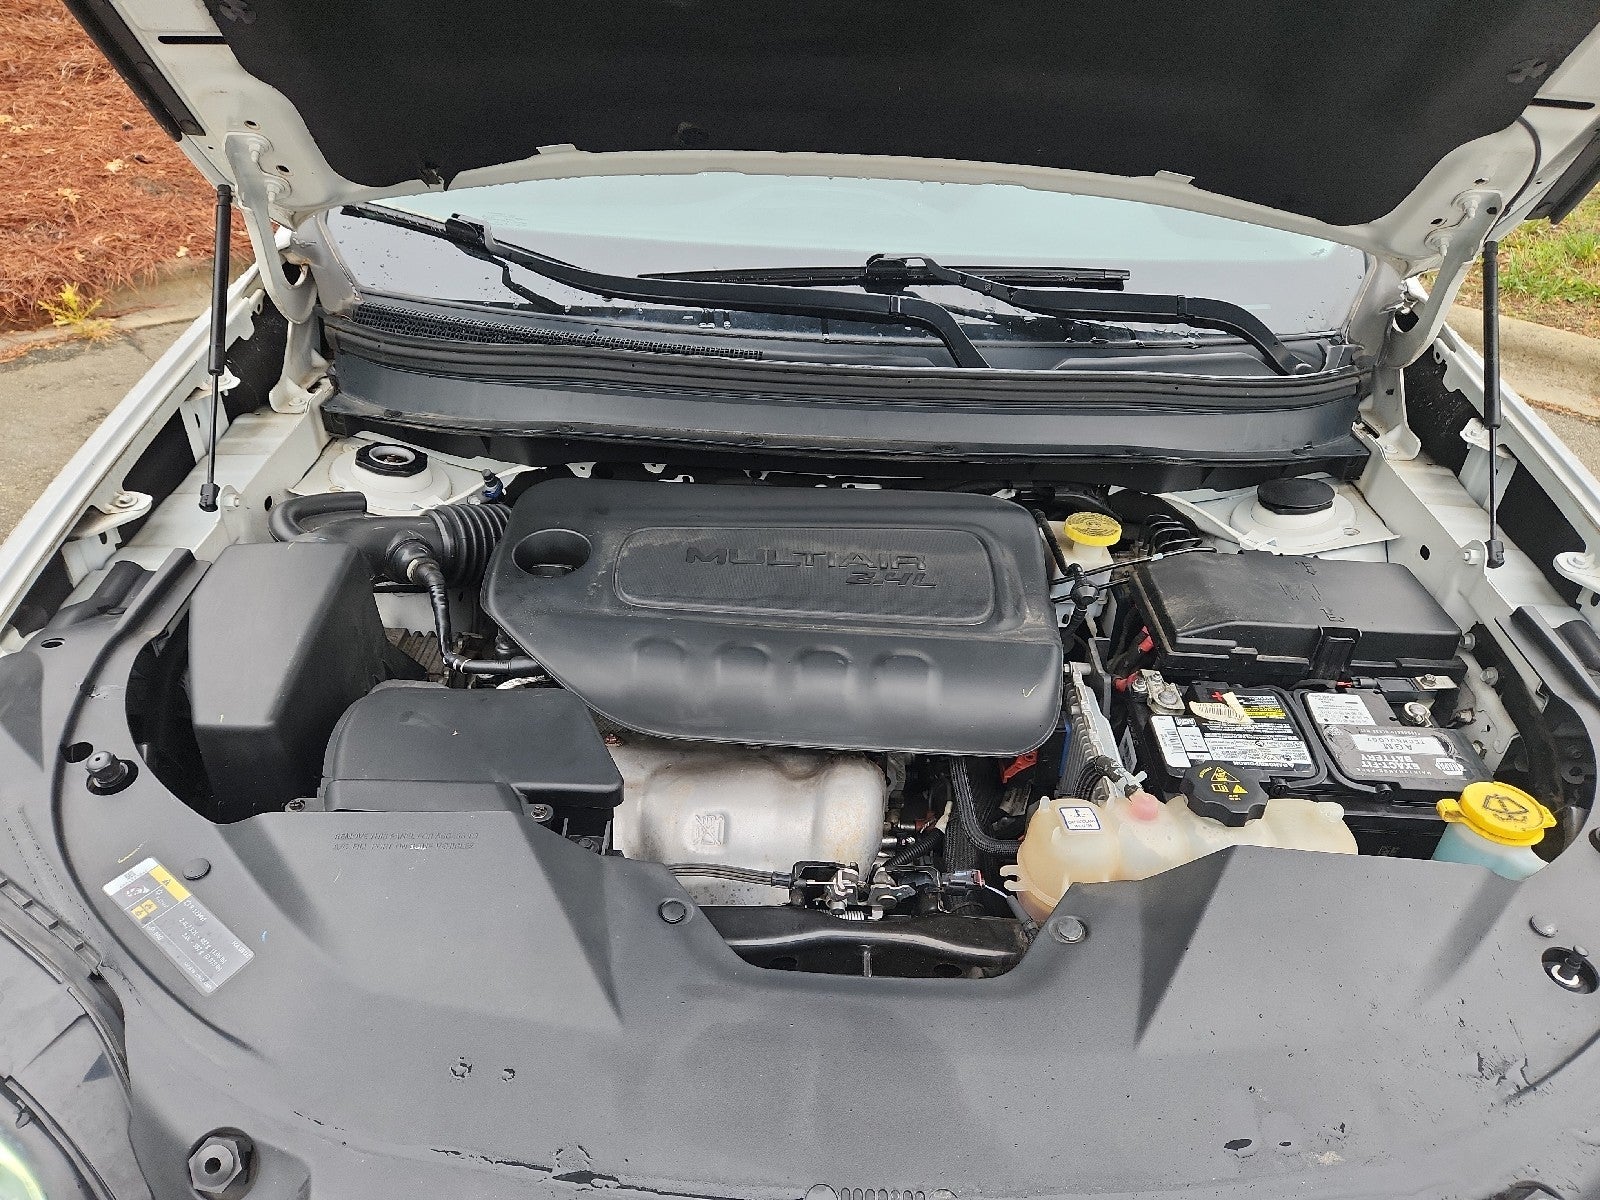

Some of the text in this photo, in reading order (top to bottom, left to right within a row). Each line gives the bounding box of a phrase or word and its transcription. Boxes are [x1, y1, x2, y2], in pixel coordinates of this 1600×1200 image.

[686, 547, 928, 571] MULTIAIR
[845, 571, 938, 588] 2.4L
[1382, 743, 1413, 751] AGM
[1360, 754, 1413, 762] BATTERY
[1361, 761, 1421, 770] EXACT-FIT
[334, 832, 368, 840] REMOVE
